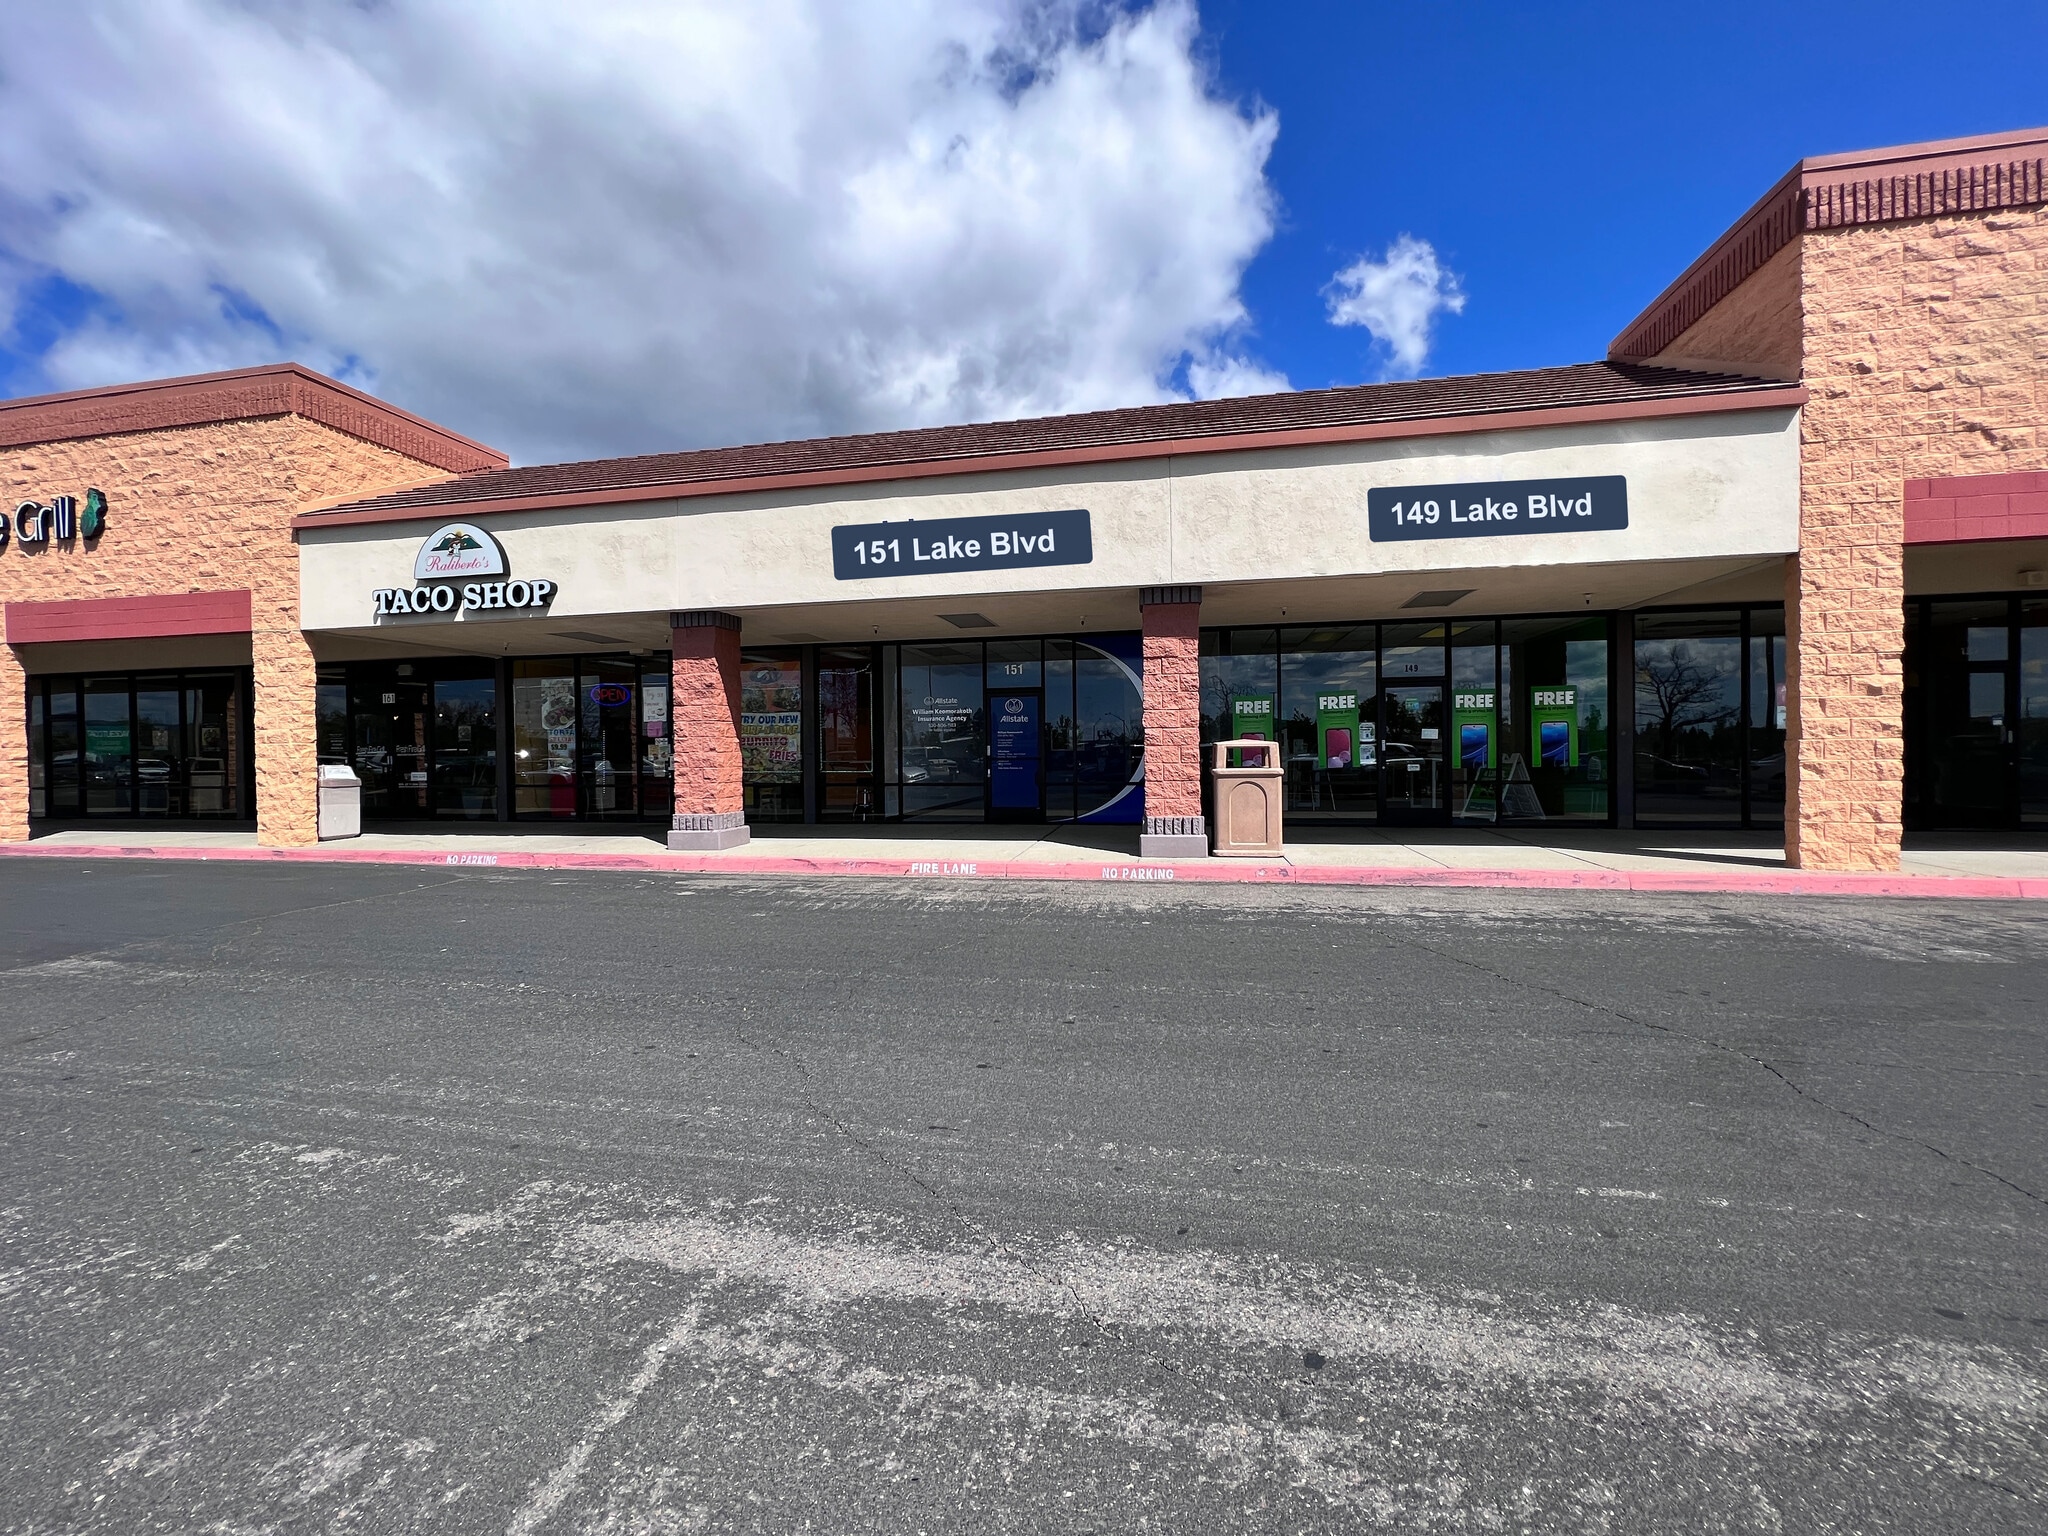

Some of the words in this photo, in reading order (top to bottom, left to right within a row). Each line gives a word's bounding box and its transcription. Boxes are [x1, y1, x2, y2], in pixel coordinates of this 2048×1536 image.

[14, 495, 72, 541] Grill
[425, 555, 489, 572] Raliberto's
[373, 585, 454, 614] TACO
[463, 579, 551, 610] SHOP
[1004, 663, 1023, 675] 151
[1404, 664, 1419, 673] 149
[383, 694, 395, 703] 161
[595, 688, 626, 701] OPEN
[1455, 694, 1494, 708] FREE
[1534, 691, 1575, 706] FREE
[1235, 701, 1271, 714] FREE
[1319, 695, 1356, 709] FREE
[758, 715, 776, 724] OUR
[778, 715, 798, 724] NEW
[1000, 715, 1029, 723] Allstate
[769, 750, 797, 761] FRIES
[446, 855, 458, 864] NO
[460, 856, 498, 865] PARKING
[911, 863, 939, 874] FIRE
[943, 864, 977, 874] LANE
[1102, 867, 1118, 879] NO
[1122, 868, 1174, 880] PARKING
